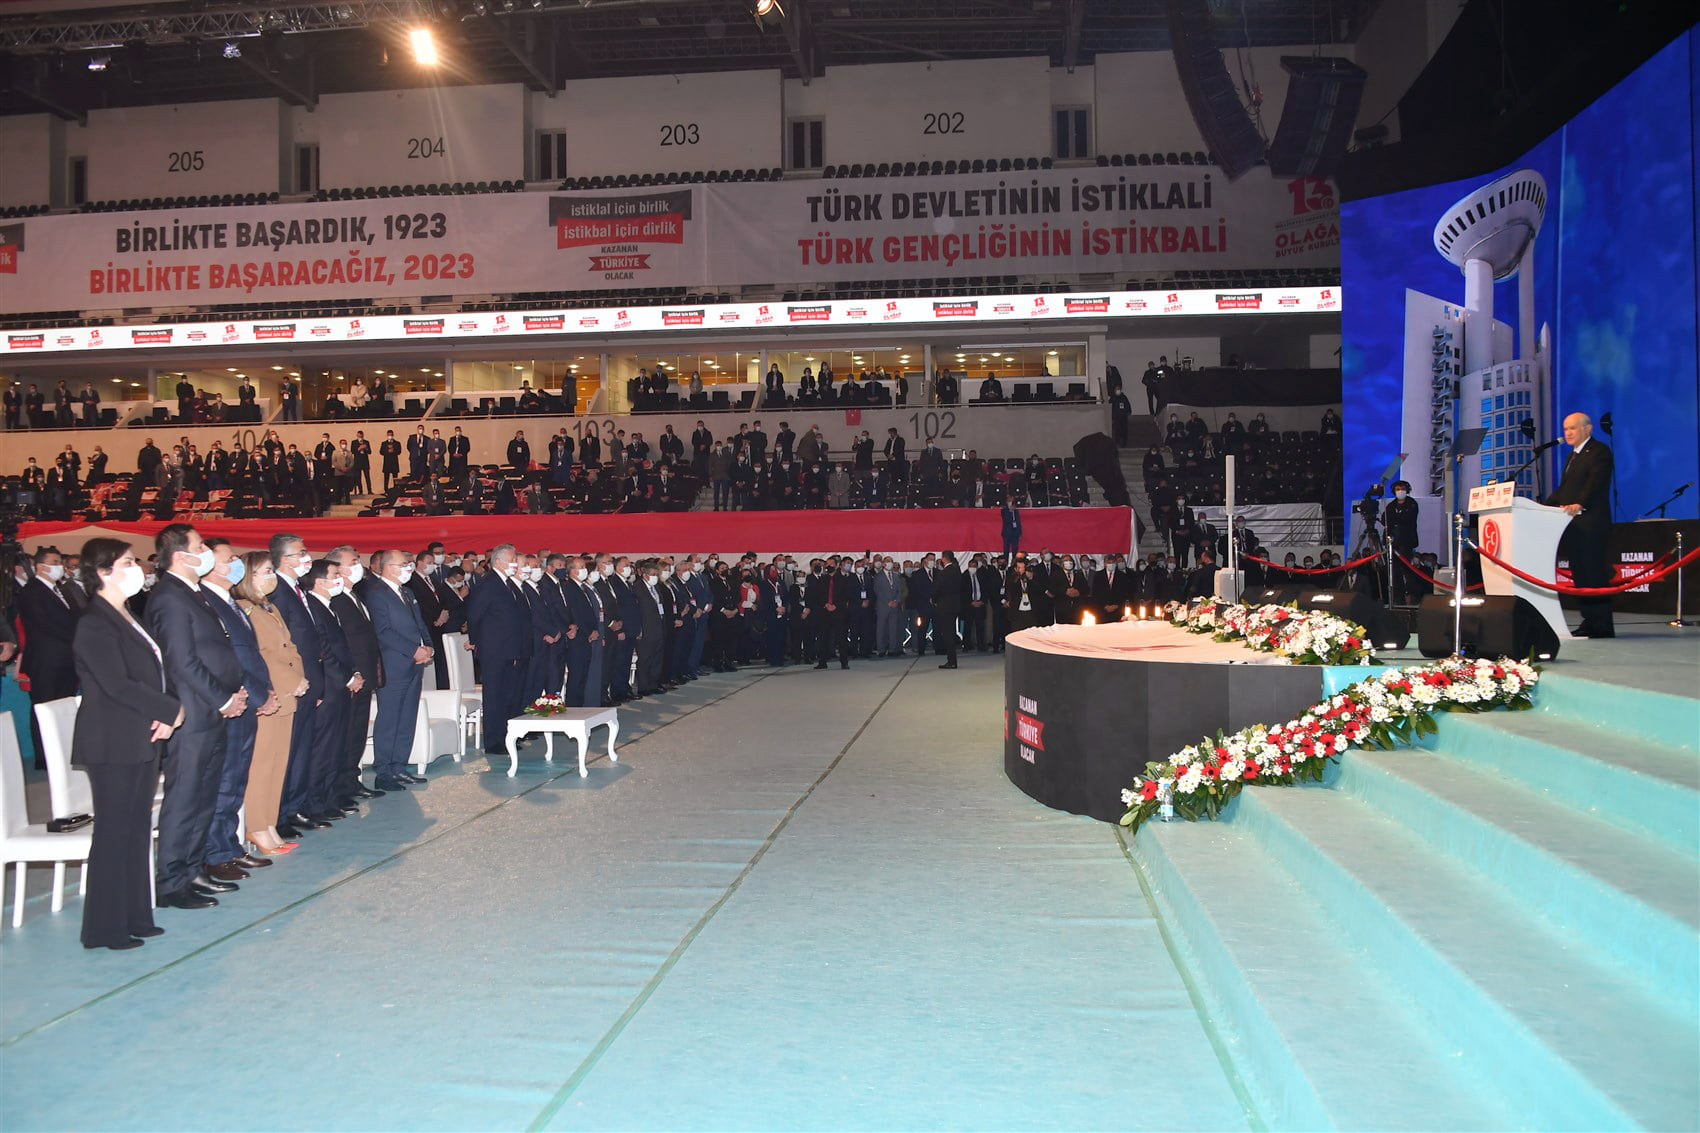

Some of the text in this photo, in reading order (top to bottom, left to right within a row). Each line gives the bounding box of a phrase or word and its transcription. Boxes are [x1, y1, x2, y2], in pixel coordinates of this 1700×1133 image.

[923, 111, 965, 135] 202
[660, 123, 700, 147] 203
[407, 137, 446, 159] 204
[167, 150, 205, 173] 205
[571, 200, 669, 217] istiklal için birlik
[807, 173, 1213, 223] TÜRK DEVLETİNİN İSTİKLALİ
[117, 212, 447, 253] BİRLİKTE BAŞARDIK, 1923
[564, 221, 677, 239] istikbal için dirlik
[601, 244, 638, 254] KAZANAN
[798, 217, 1227, 270] TÜRK GENÇLİĞİNİN İSTİKBALİ
[90, 250, 475, 294] BİRLİKTE BAŞARACAĞIZ, 2023
[600, 256, 640, 269] TÜRKİYE
[604, 271, 634, 280] OLACAK
[573, 420, 616, 447] 103
[909, 411, 956, 440] 102
[1621, 552, 1654, 562] KAZANAN
